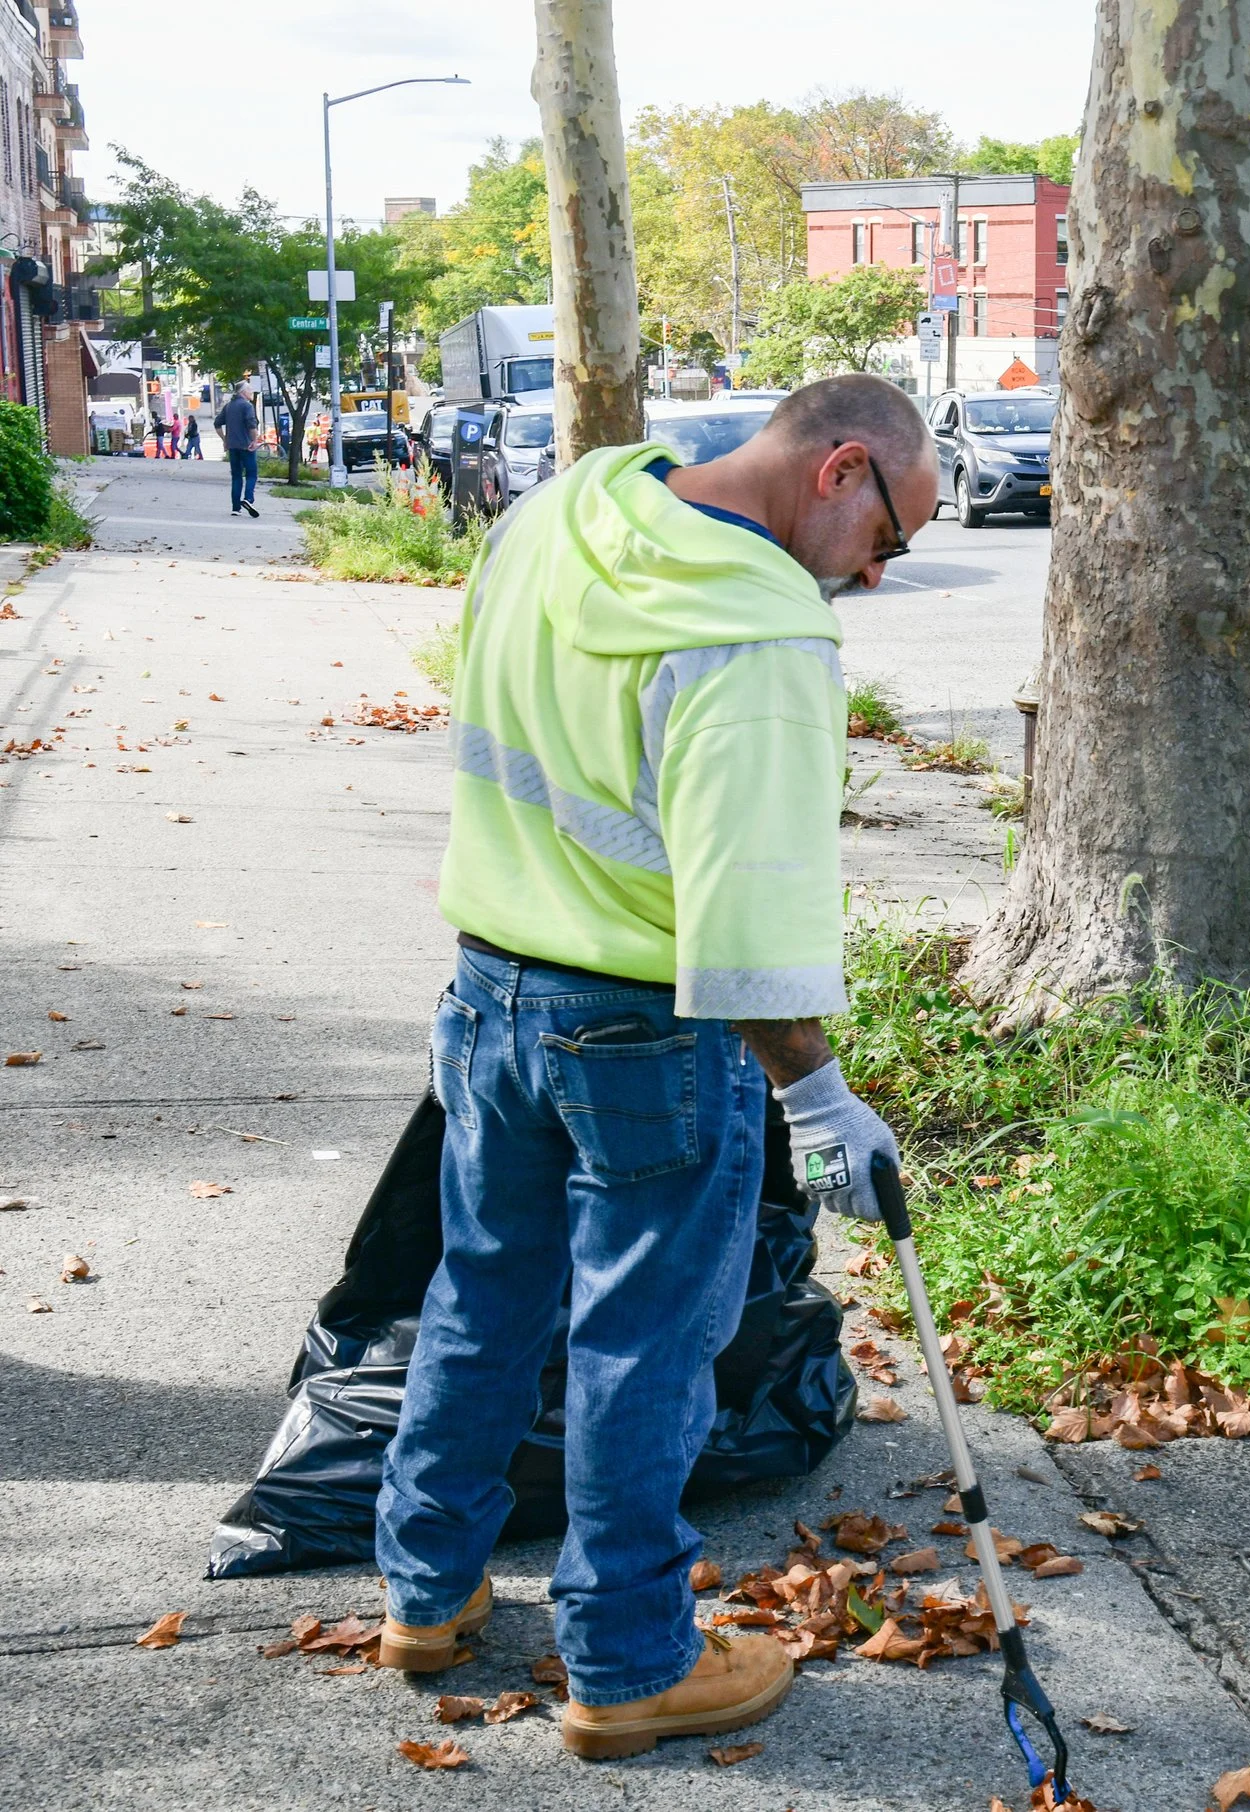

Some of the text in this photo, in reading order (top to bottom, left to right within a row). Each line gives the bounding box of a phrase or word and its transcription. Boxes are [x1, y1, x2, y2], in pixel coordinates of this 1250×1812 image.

[292, 318, 317, 329] Central
[361, 400, 382, 412] CAT
[467, 424, 478, 439] P
